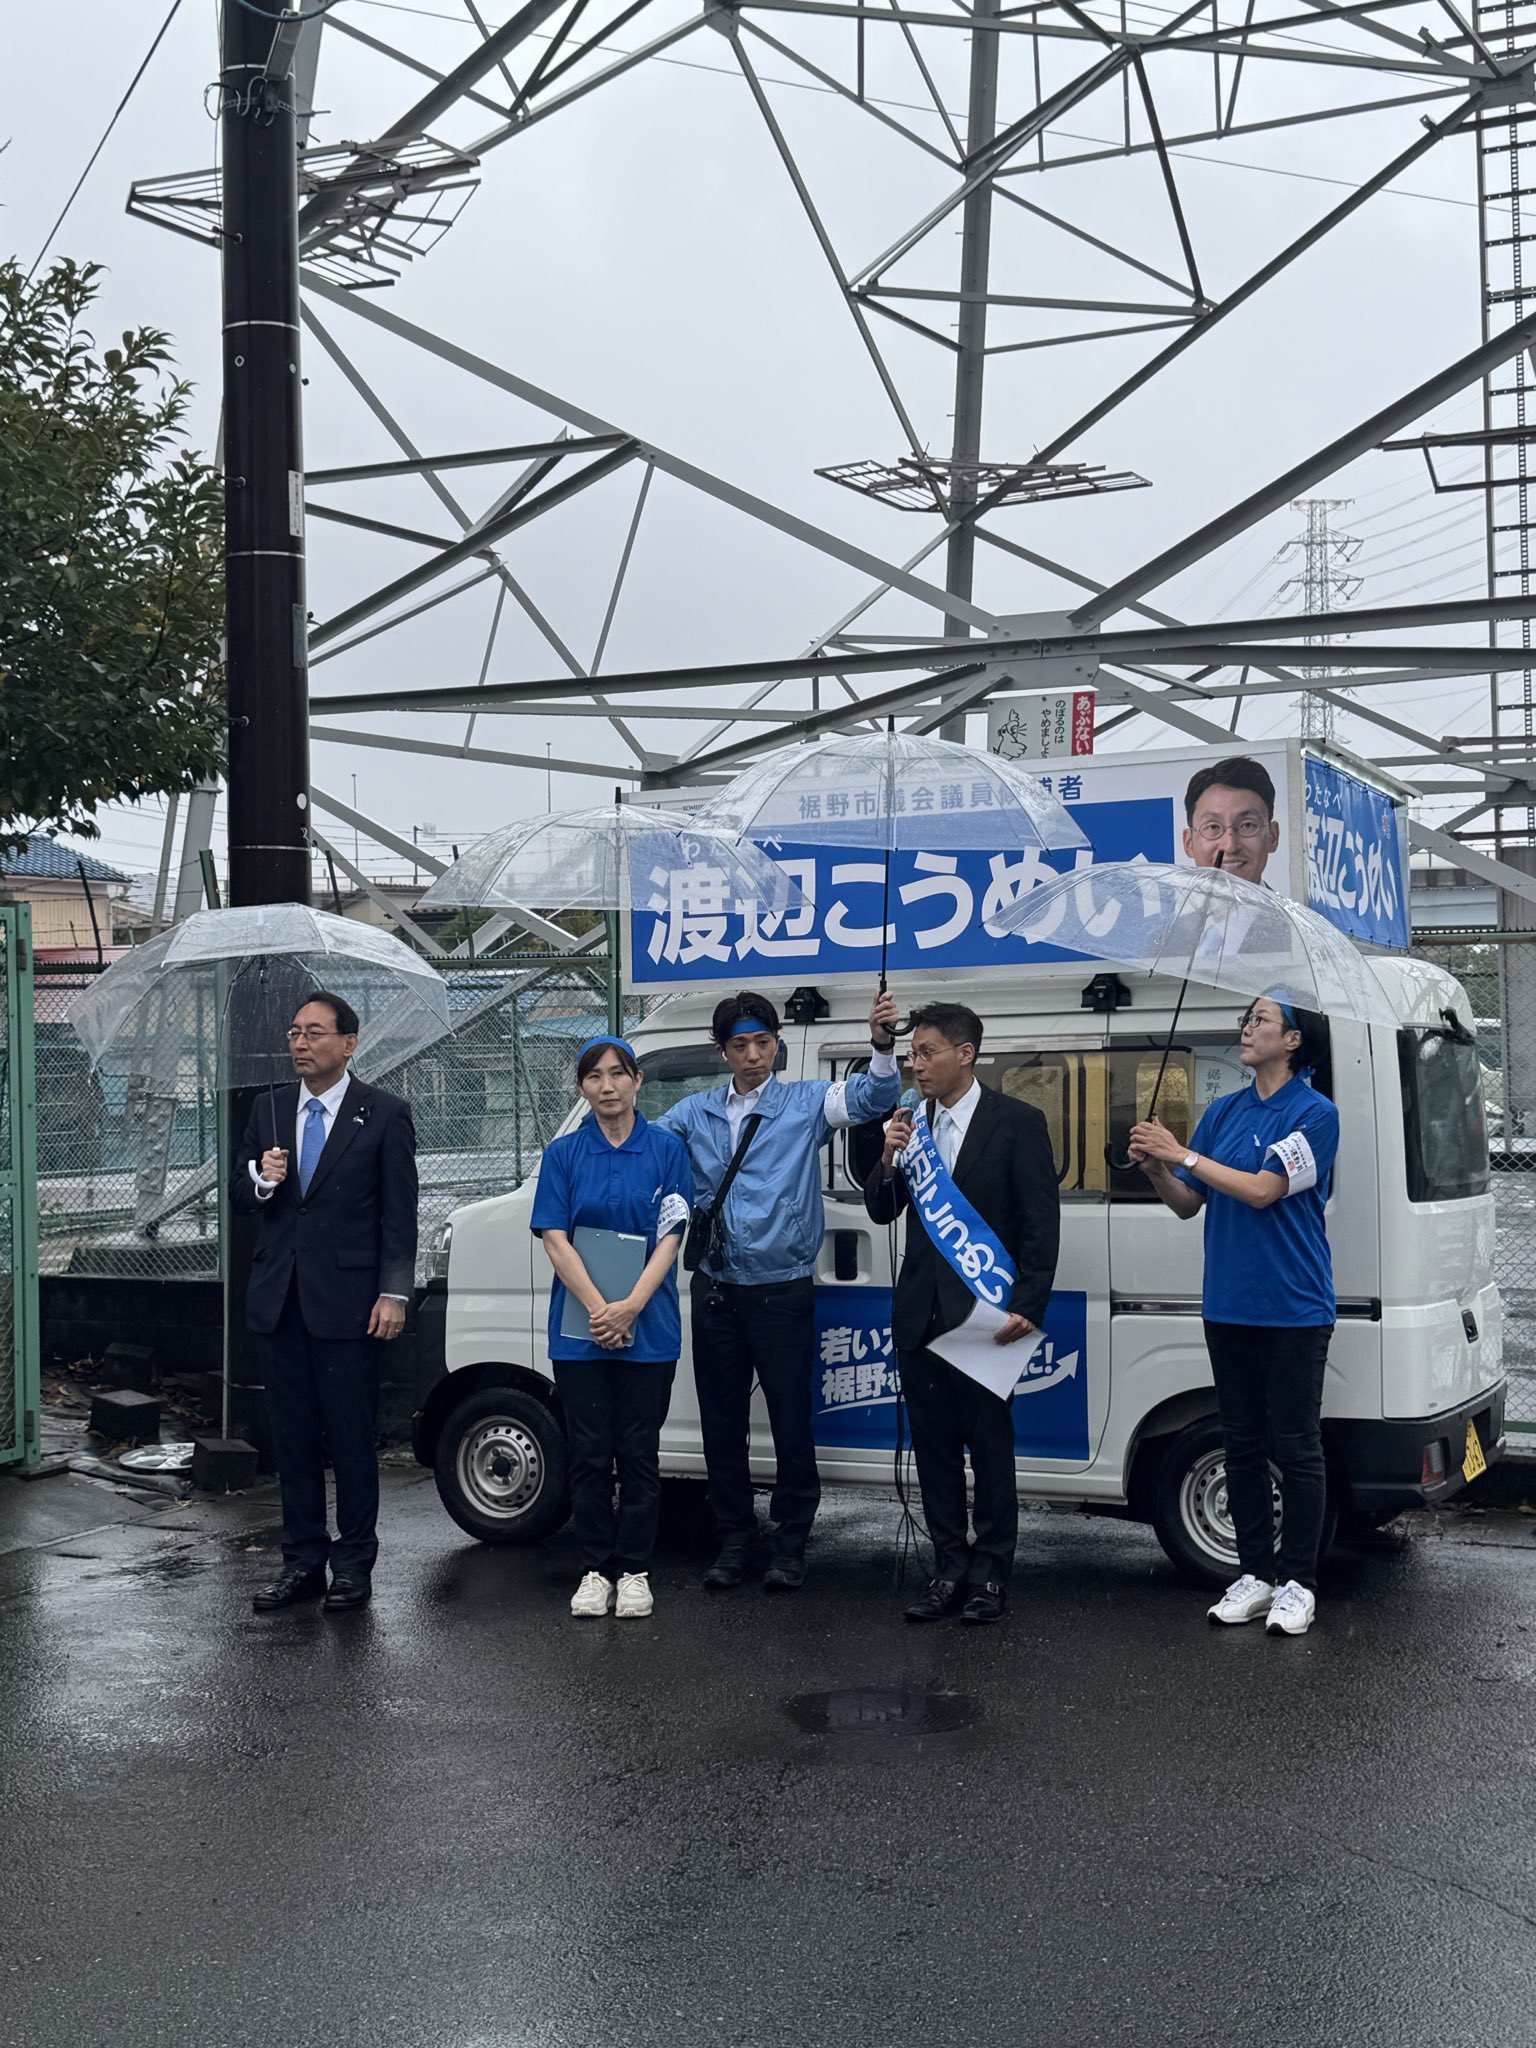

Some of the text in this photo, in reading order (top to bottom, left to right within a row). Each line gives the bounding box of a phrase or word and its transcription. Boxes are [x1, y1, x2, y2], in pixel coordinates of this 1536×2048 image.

[1054, 699, 1066, 744] のぼるのは
[1075, 695, 1091, 755] あぶない
[798, 774, 1083, 820] 裾野市議会議員者
[681, 833, 783, 858] わたべ
[646, 845, 1162, 966] 渡辺こうめい
